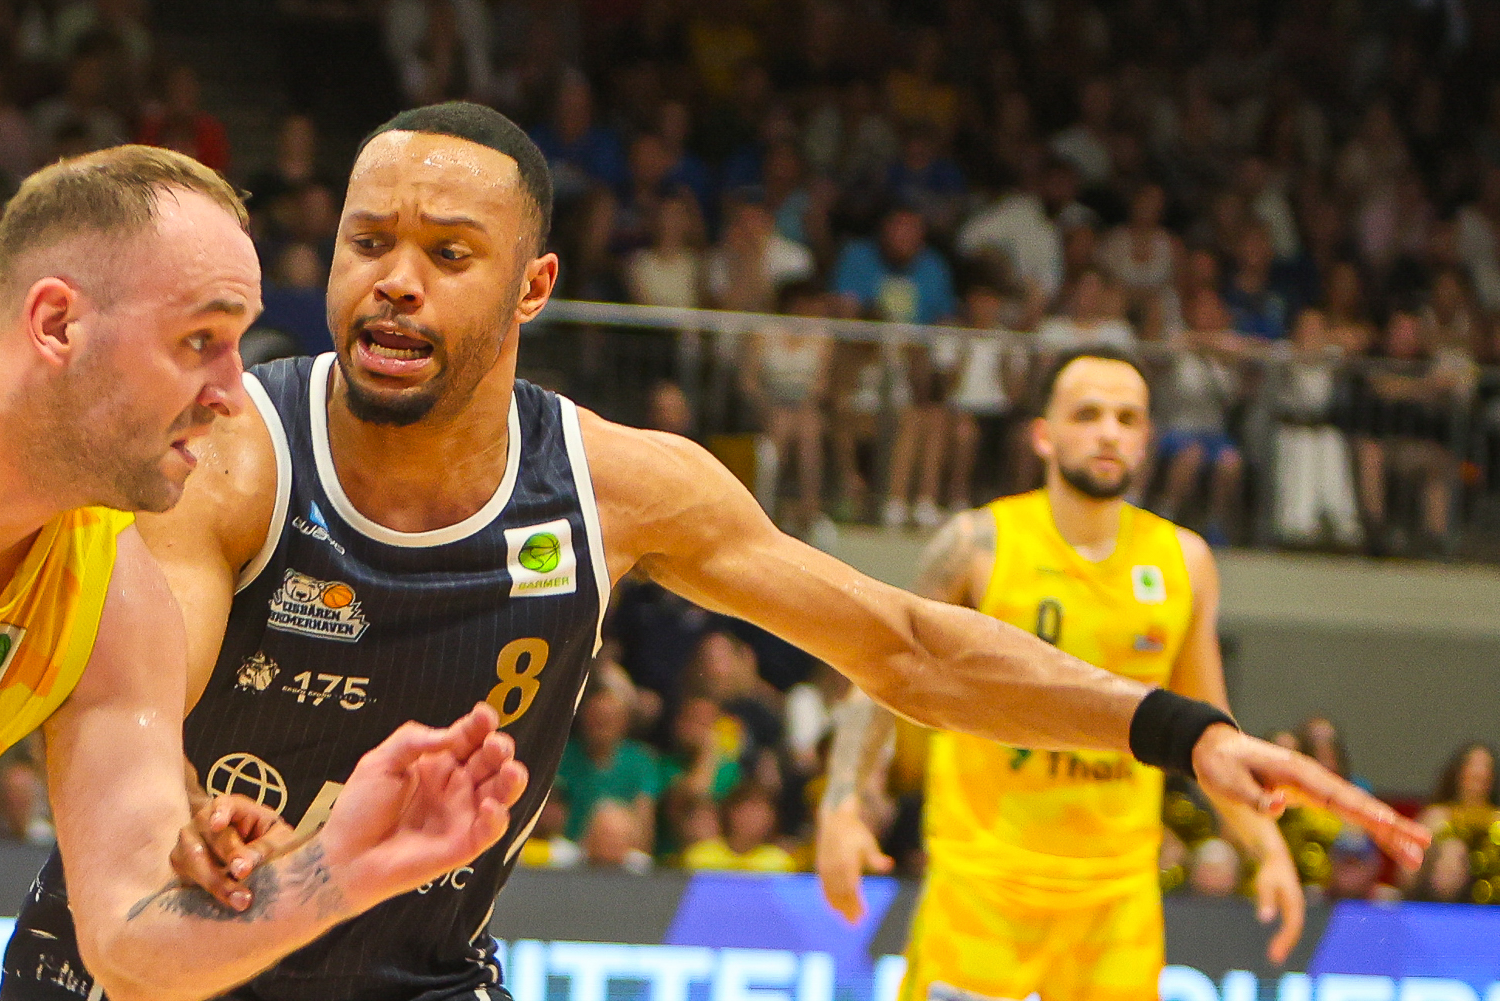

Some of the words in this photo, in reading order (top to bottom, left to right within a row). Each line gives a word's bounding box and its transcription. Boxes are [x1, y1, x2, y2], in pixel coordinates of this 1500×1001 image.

[518, 576, 570, 591] BARMER
[294, 671, 370, 710] 175
[485, 637, 549, 728] 8
